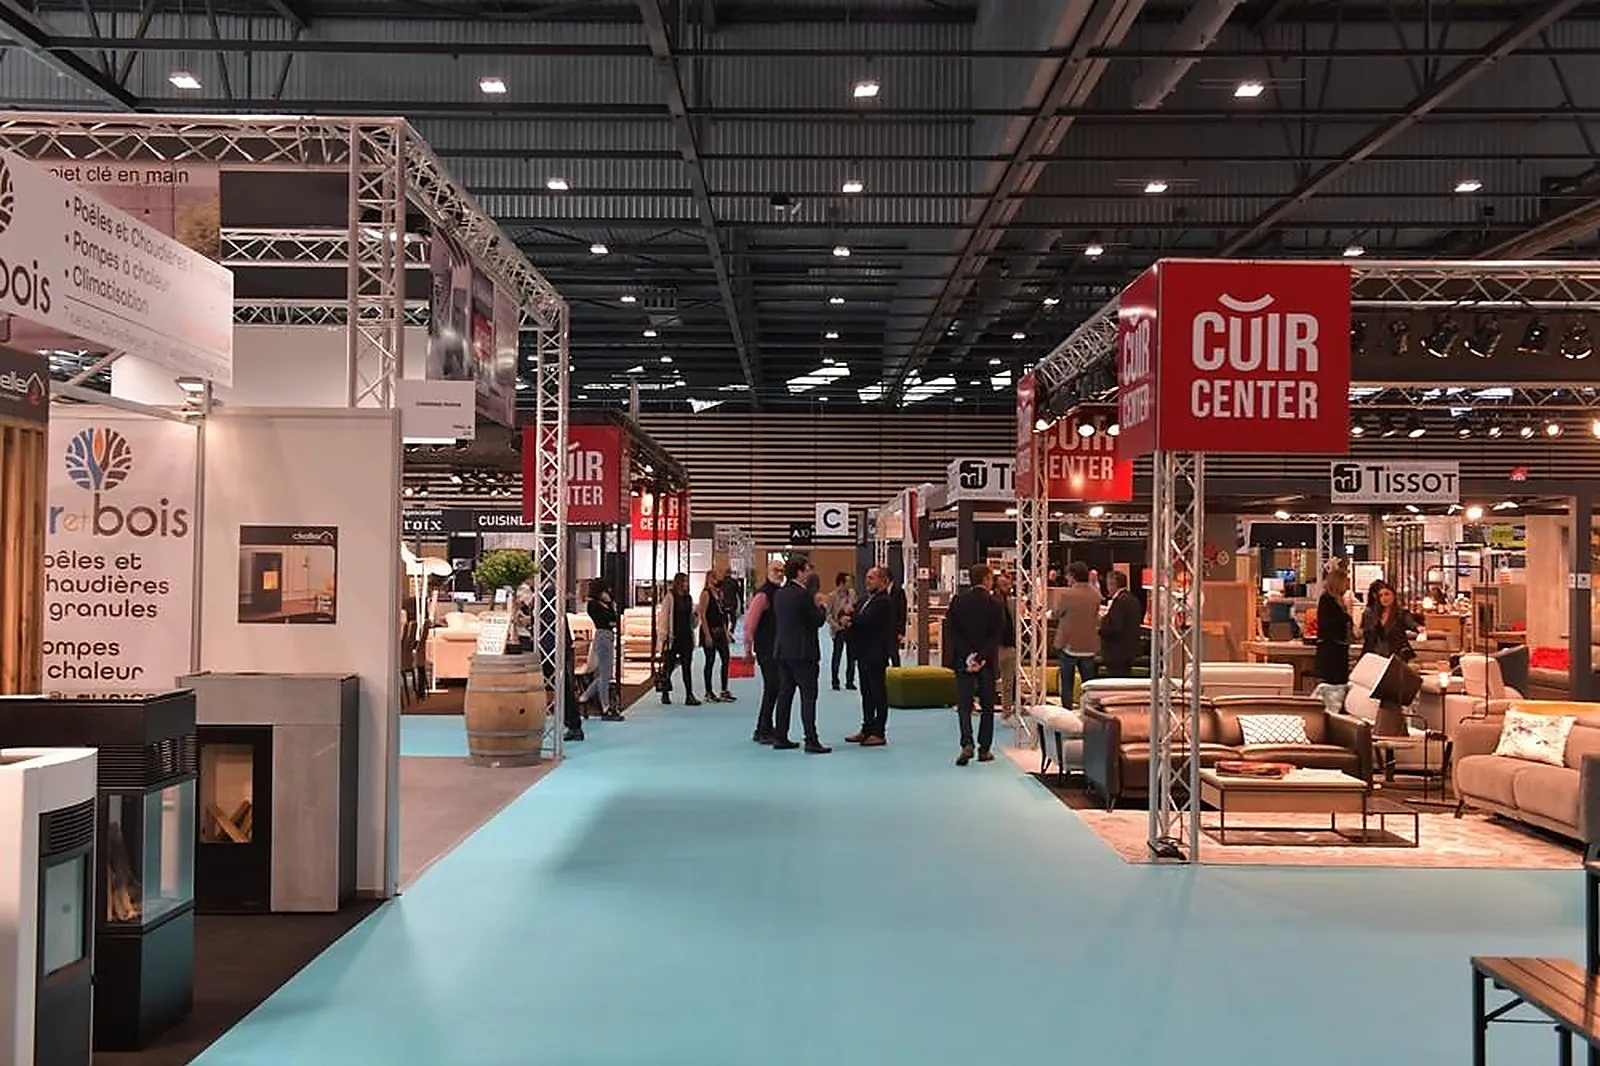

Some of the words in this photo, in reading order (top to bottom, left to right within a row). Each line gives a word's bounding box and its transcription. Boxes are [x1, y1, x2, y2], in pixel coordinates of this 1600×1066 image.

[87, 166, 112, 182] clé
[117, 169, 140, 182] en
[146, 167, 189, 184] main
[74, 196, 112, 235] Poêles
[116, 221, 128, 242] et
[74, 230, 118, 270] Pompes
[73, 266, 149, 314] Climatisation
[1123, 319, 1150, 386] CUIR
[1192, 311, 1320, 371] CUIR
[1122, 383, 1150, 429] CENTER
[1191, 379, 1318, 419] CENTER
[1049, 455, 1114, 480] ENTER
[93, 493, 188, 538] bois
[479, 515, 534, 527] CUISIN
[822, 508, 842, 530] C
[115, 553, 142, 570] et
[47, 661, 144, 680] chaleur
